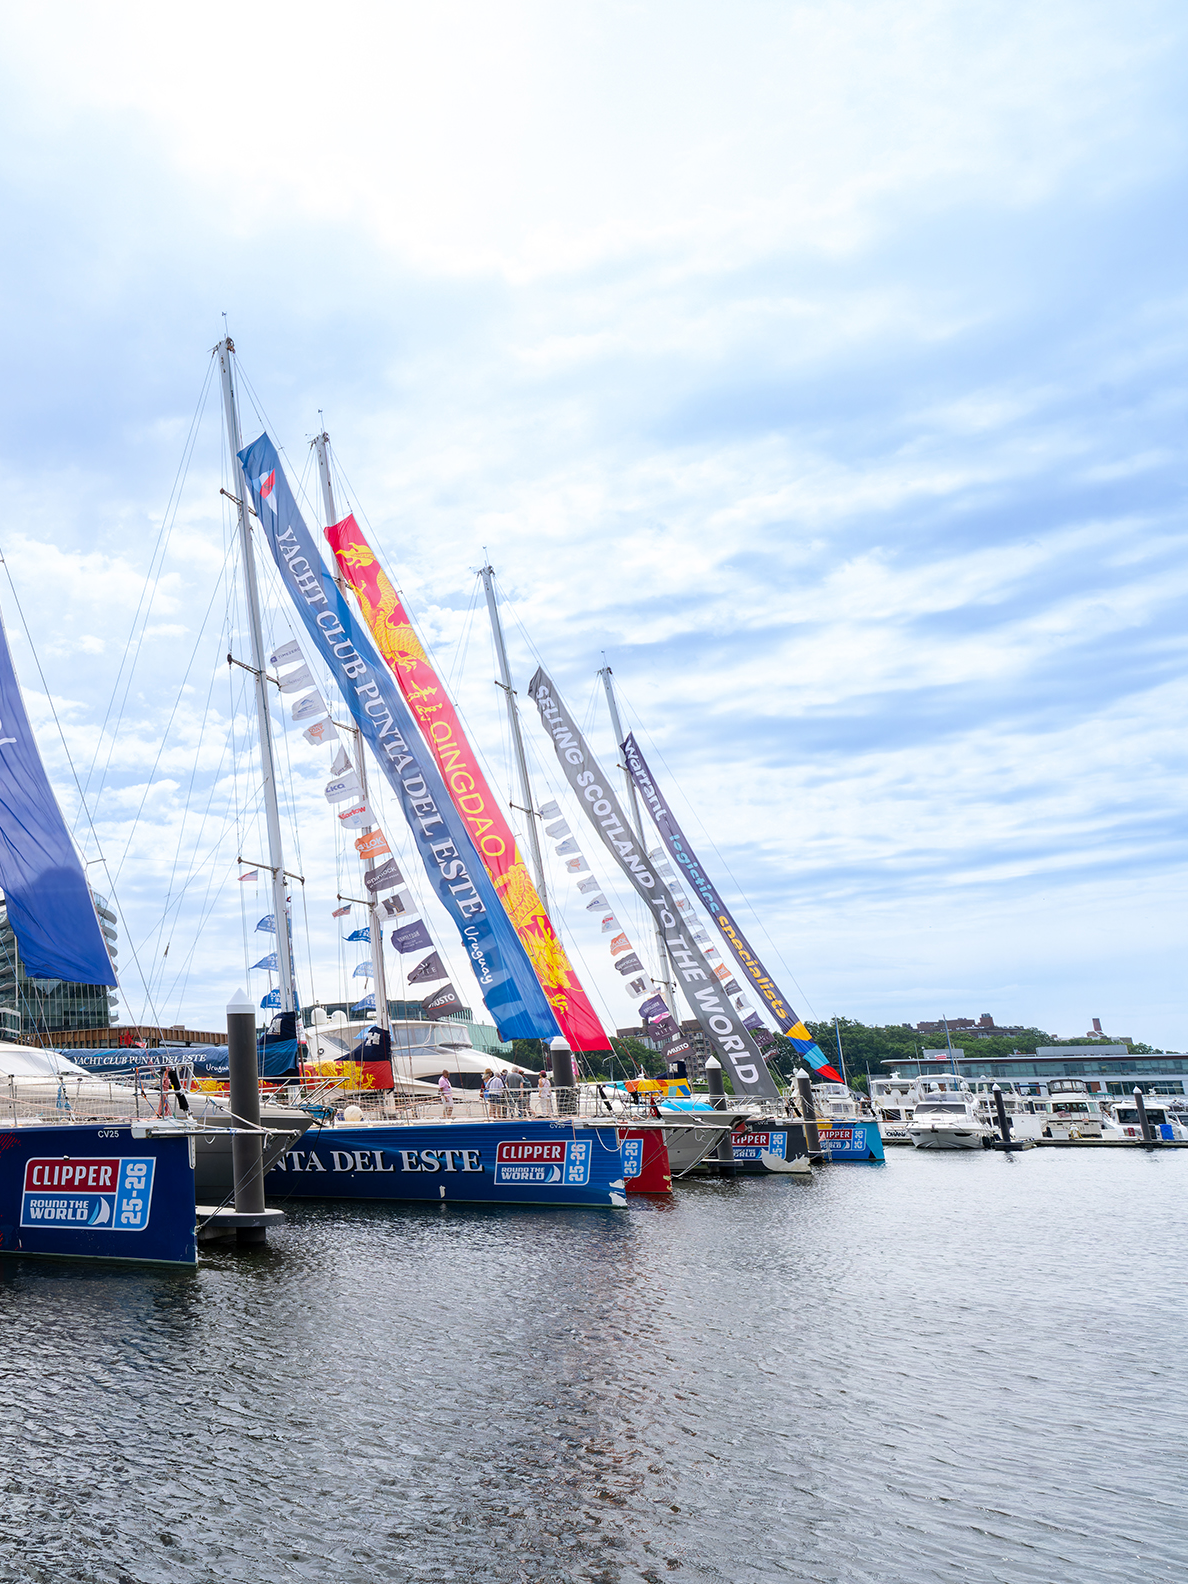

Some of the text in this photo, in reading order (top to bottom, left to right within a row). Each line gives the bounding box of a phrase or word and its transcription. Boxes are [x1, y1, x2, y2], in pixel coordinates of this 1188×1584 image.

[275, 524, 329, 606] YACHT
[316, 609, 368, 679] CLUB
[353, 678, 415, 775] PUNTA
[402, 773, 445, 837] DEL
[429, 837, 486, 919] ESTE
[429, 720, 506, 857] QINGDAO
[535, 684, 760, 1084] SELLING SCOTLAND TO THE WORLD
[623, 739, 668, 822] Warrant
[716, 914, 789, 1019] specialists
[463, 925, 494, 986] Uruguay
[666, 1042, 690, 1056] MUSTO
[73, 1055, 105, 1065] YACHT
[102, 1055, 128, 1065] CLUB
[128, 1055, 161, 1065] PUNTA
[205, 1062, 230, 1075] Urugua
[97, 1129, 120, 1139] CV25
[732, 1134, 767, 1144] LIPPER
[502, 1145, 562, 1160] CLIPPER
[623, 1141, 639, 1175] 25-26
[271, 1149, 483, 1172] NTA DEL ESTE
[32, 1165, 113, 1187] CLIPPER
[501, 1166, 546, 1174] ROUND THE
[501, 1171, 545, 1181] WORLD
[120, 1163, 148, 1225] 25-26
[30, 1199, 90, 1209] ROUND THE
[29, 1207, 89, 1222] WORLD
